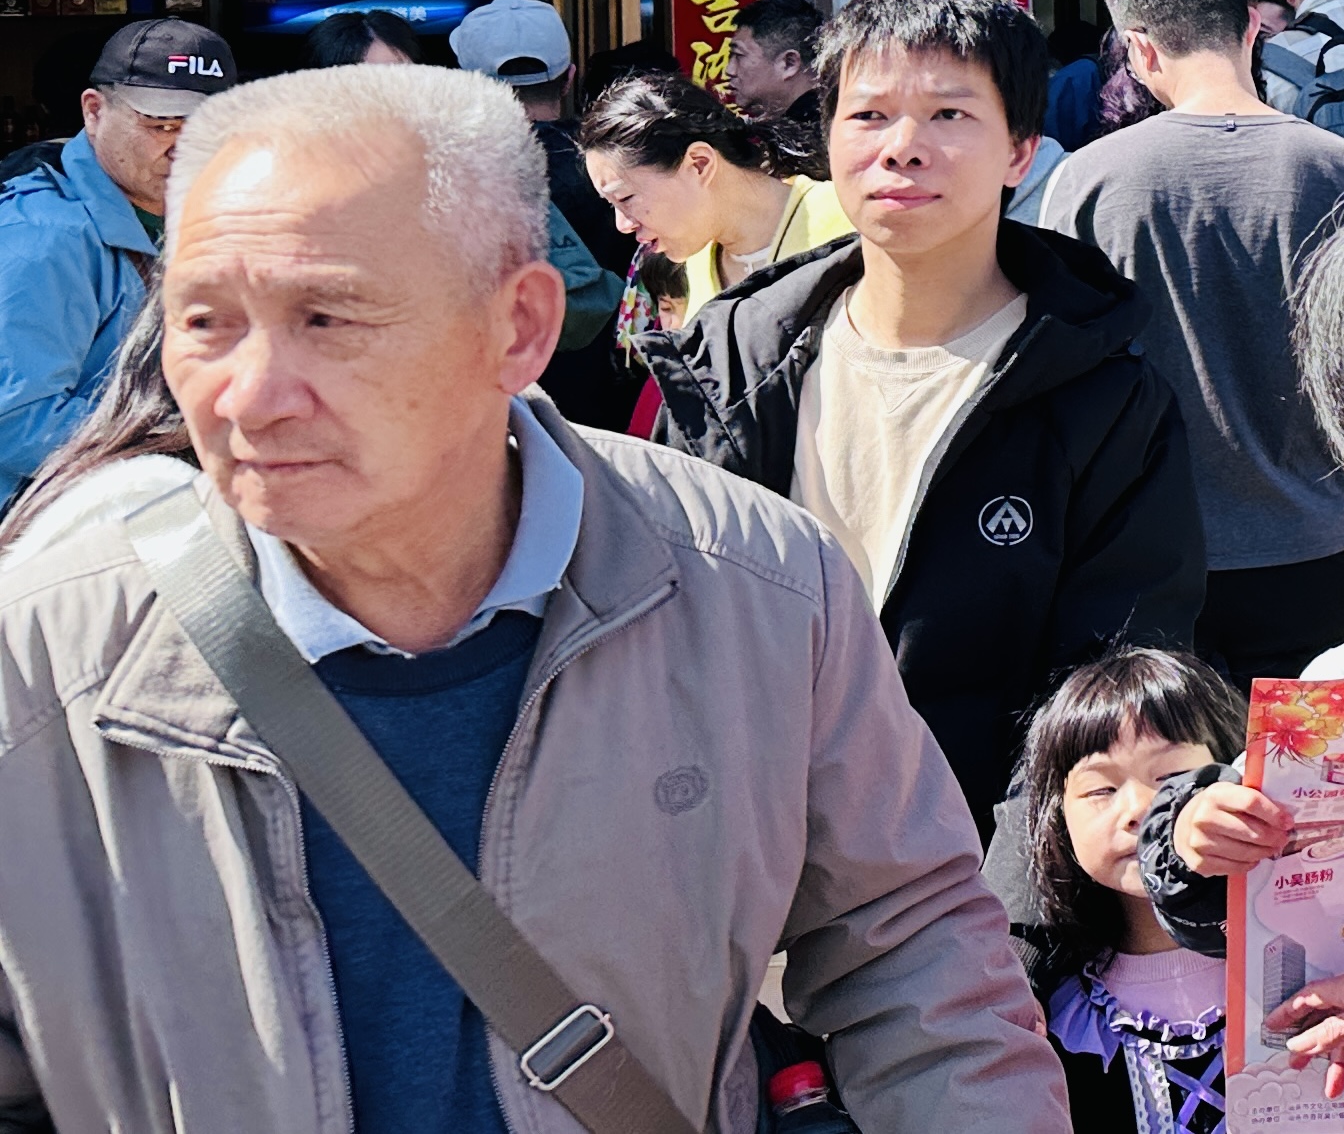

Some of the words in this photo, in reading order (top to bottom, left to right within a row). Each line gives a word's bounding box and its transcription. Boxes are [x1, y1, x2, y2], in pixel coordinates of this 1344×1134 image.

[167, 54, 225, 79] FILA
[1274, 868, 1334, 890] 小吴肠粉
